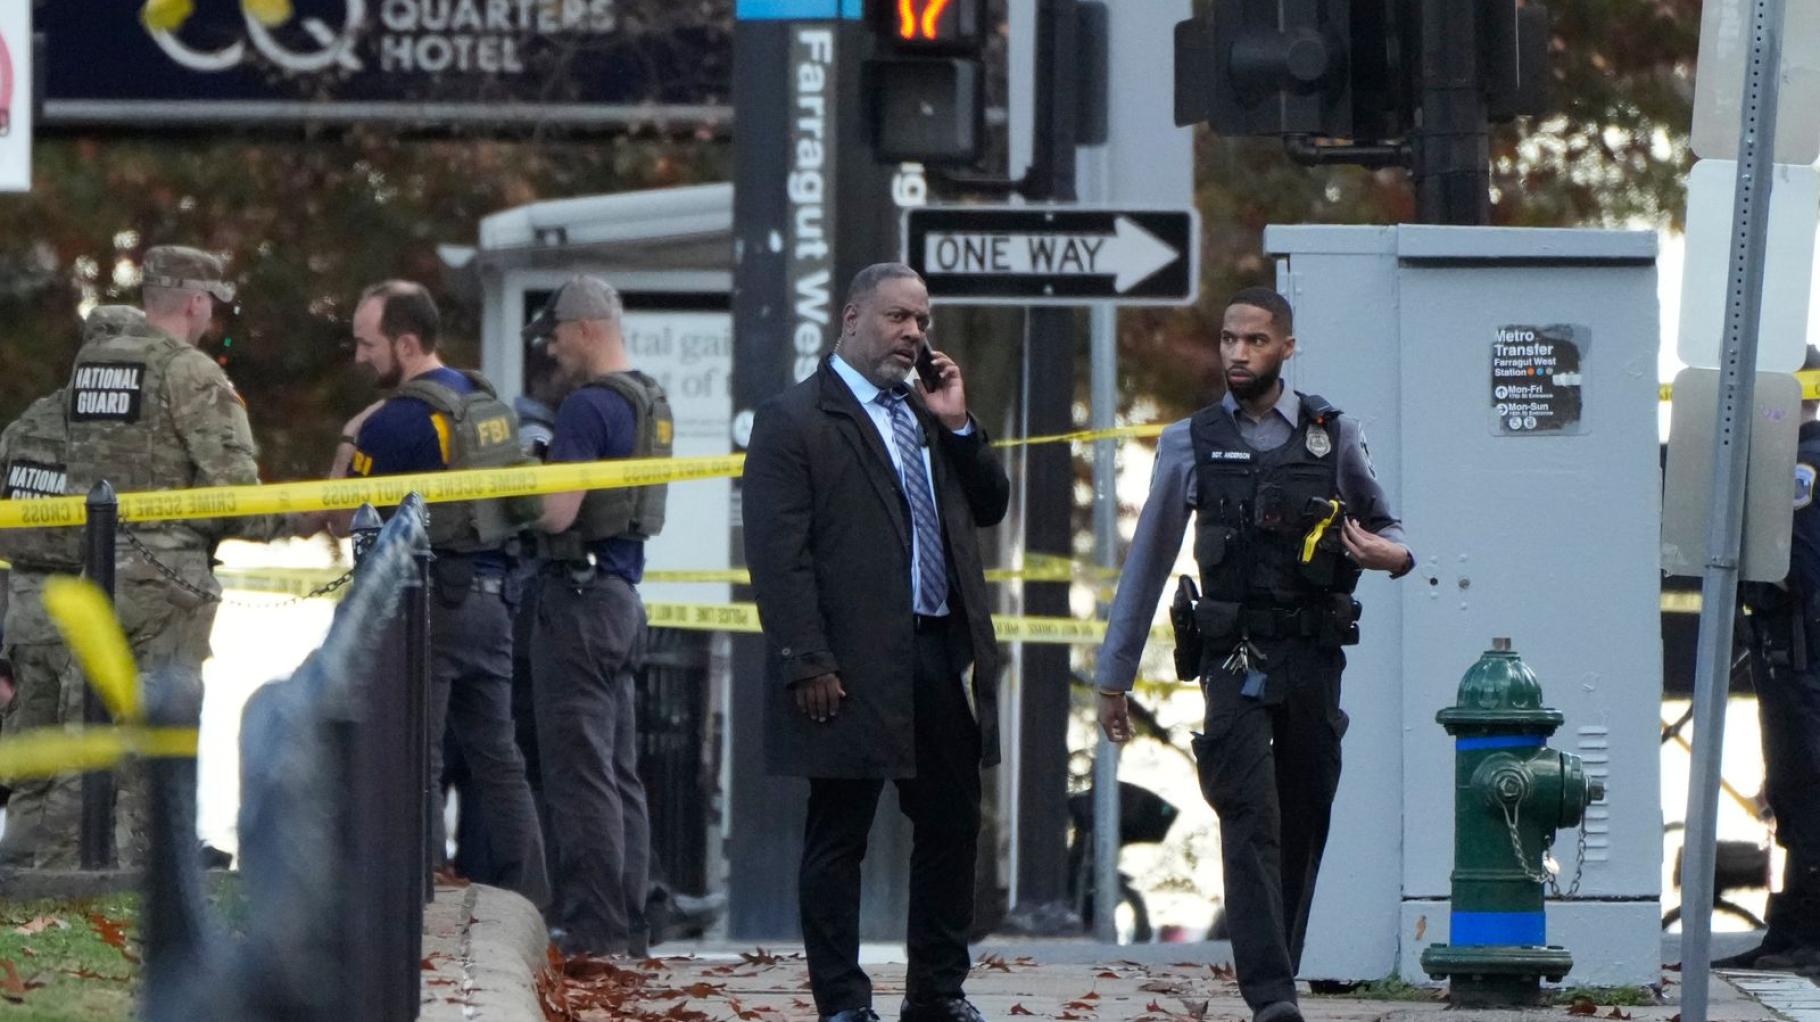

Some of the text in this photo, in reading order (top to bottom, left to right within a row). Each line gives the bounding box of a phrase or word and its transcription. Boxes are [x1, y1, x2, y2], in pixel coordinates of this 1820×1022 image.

[381, 0, 616, 33] QUARTERS
[381, 34, 523, 72] HOTEL
[786, 30, 833, 384] Farragut Wes
[936, 236, 1105, 272] ONE WAY
[1496, 330, 1535, 342] Metro
[1494, 344, 1554, 356] Transfer
[1494, 358, 1557, 368] Farragut West
[75, 367, 140, 390] NATIONAL
[1508, 384, 1543, 394] Mon-Fri
[77, 391, 130, 414] GUARD
[1508, 402, 1549, 410] Mon-Sun
[477, 417, 510, 447] FBI
[8, 466, 66, 494] NATIONA
